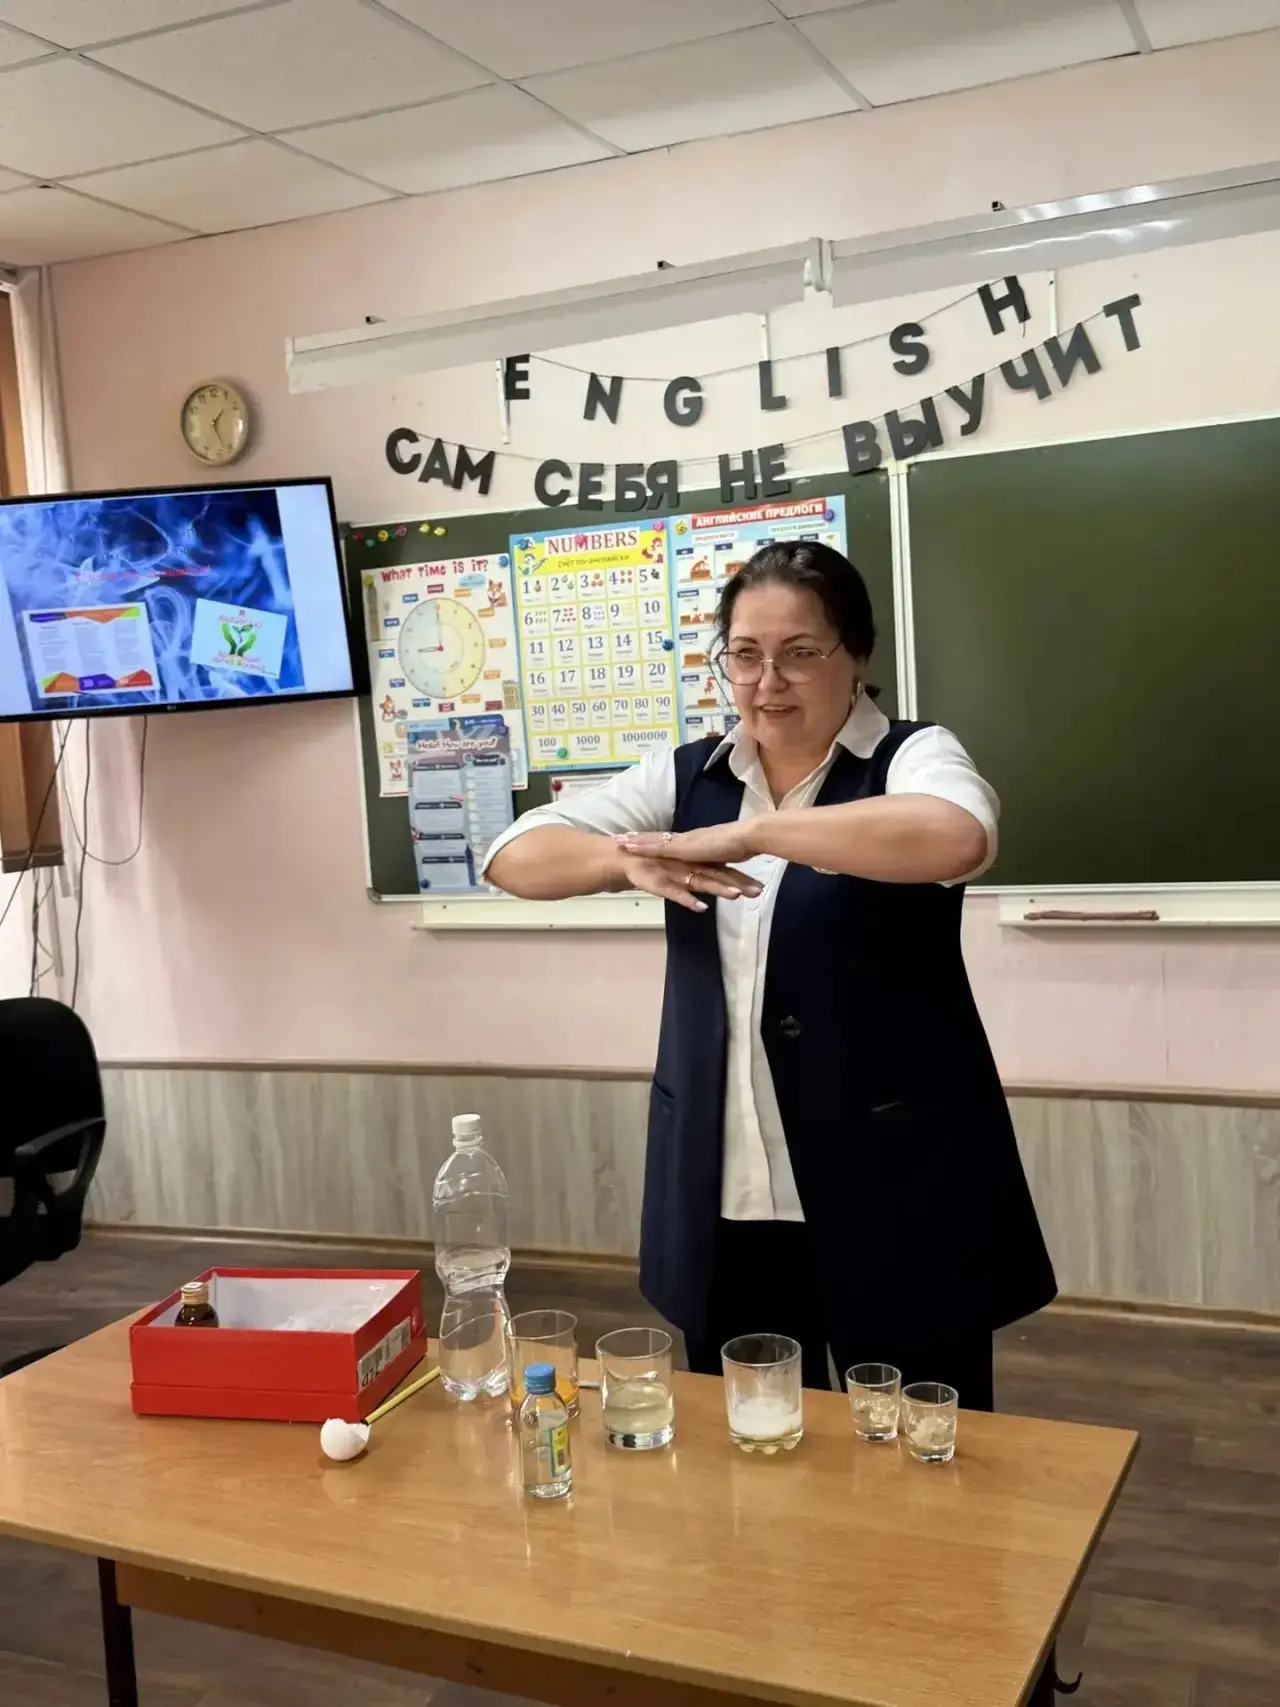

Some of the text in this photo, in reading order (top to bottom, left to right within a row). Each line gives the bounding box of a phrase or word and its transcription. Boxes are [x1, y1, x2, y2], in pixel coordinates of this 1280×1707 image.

[505, 275, 1032, 426] ENGLISH
[385, 293, 1142, 512] САМ СЕБЯ НЕ ВЫУЧИТ
[696, 503, 824, 527] АНГЛИЙСКИЕ ПРЕДЛОГИ
[523, 569, 648, 594] 1 2 3 4 5
[524, 600, 660, 625] 6 7 8 9 10
[530, 631, 663, 654] 11 12 13 14 15
[530, 663, 666, 685] 16 17 18 19 20
[531, 697, 670, 716] 30 40 50 60 70 80 90
[538, 731, 667, 747] 100 1000 1000000
